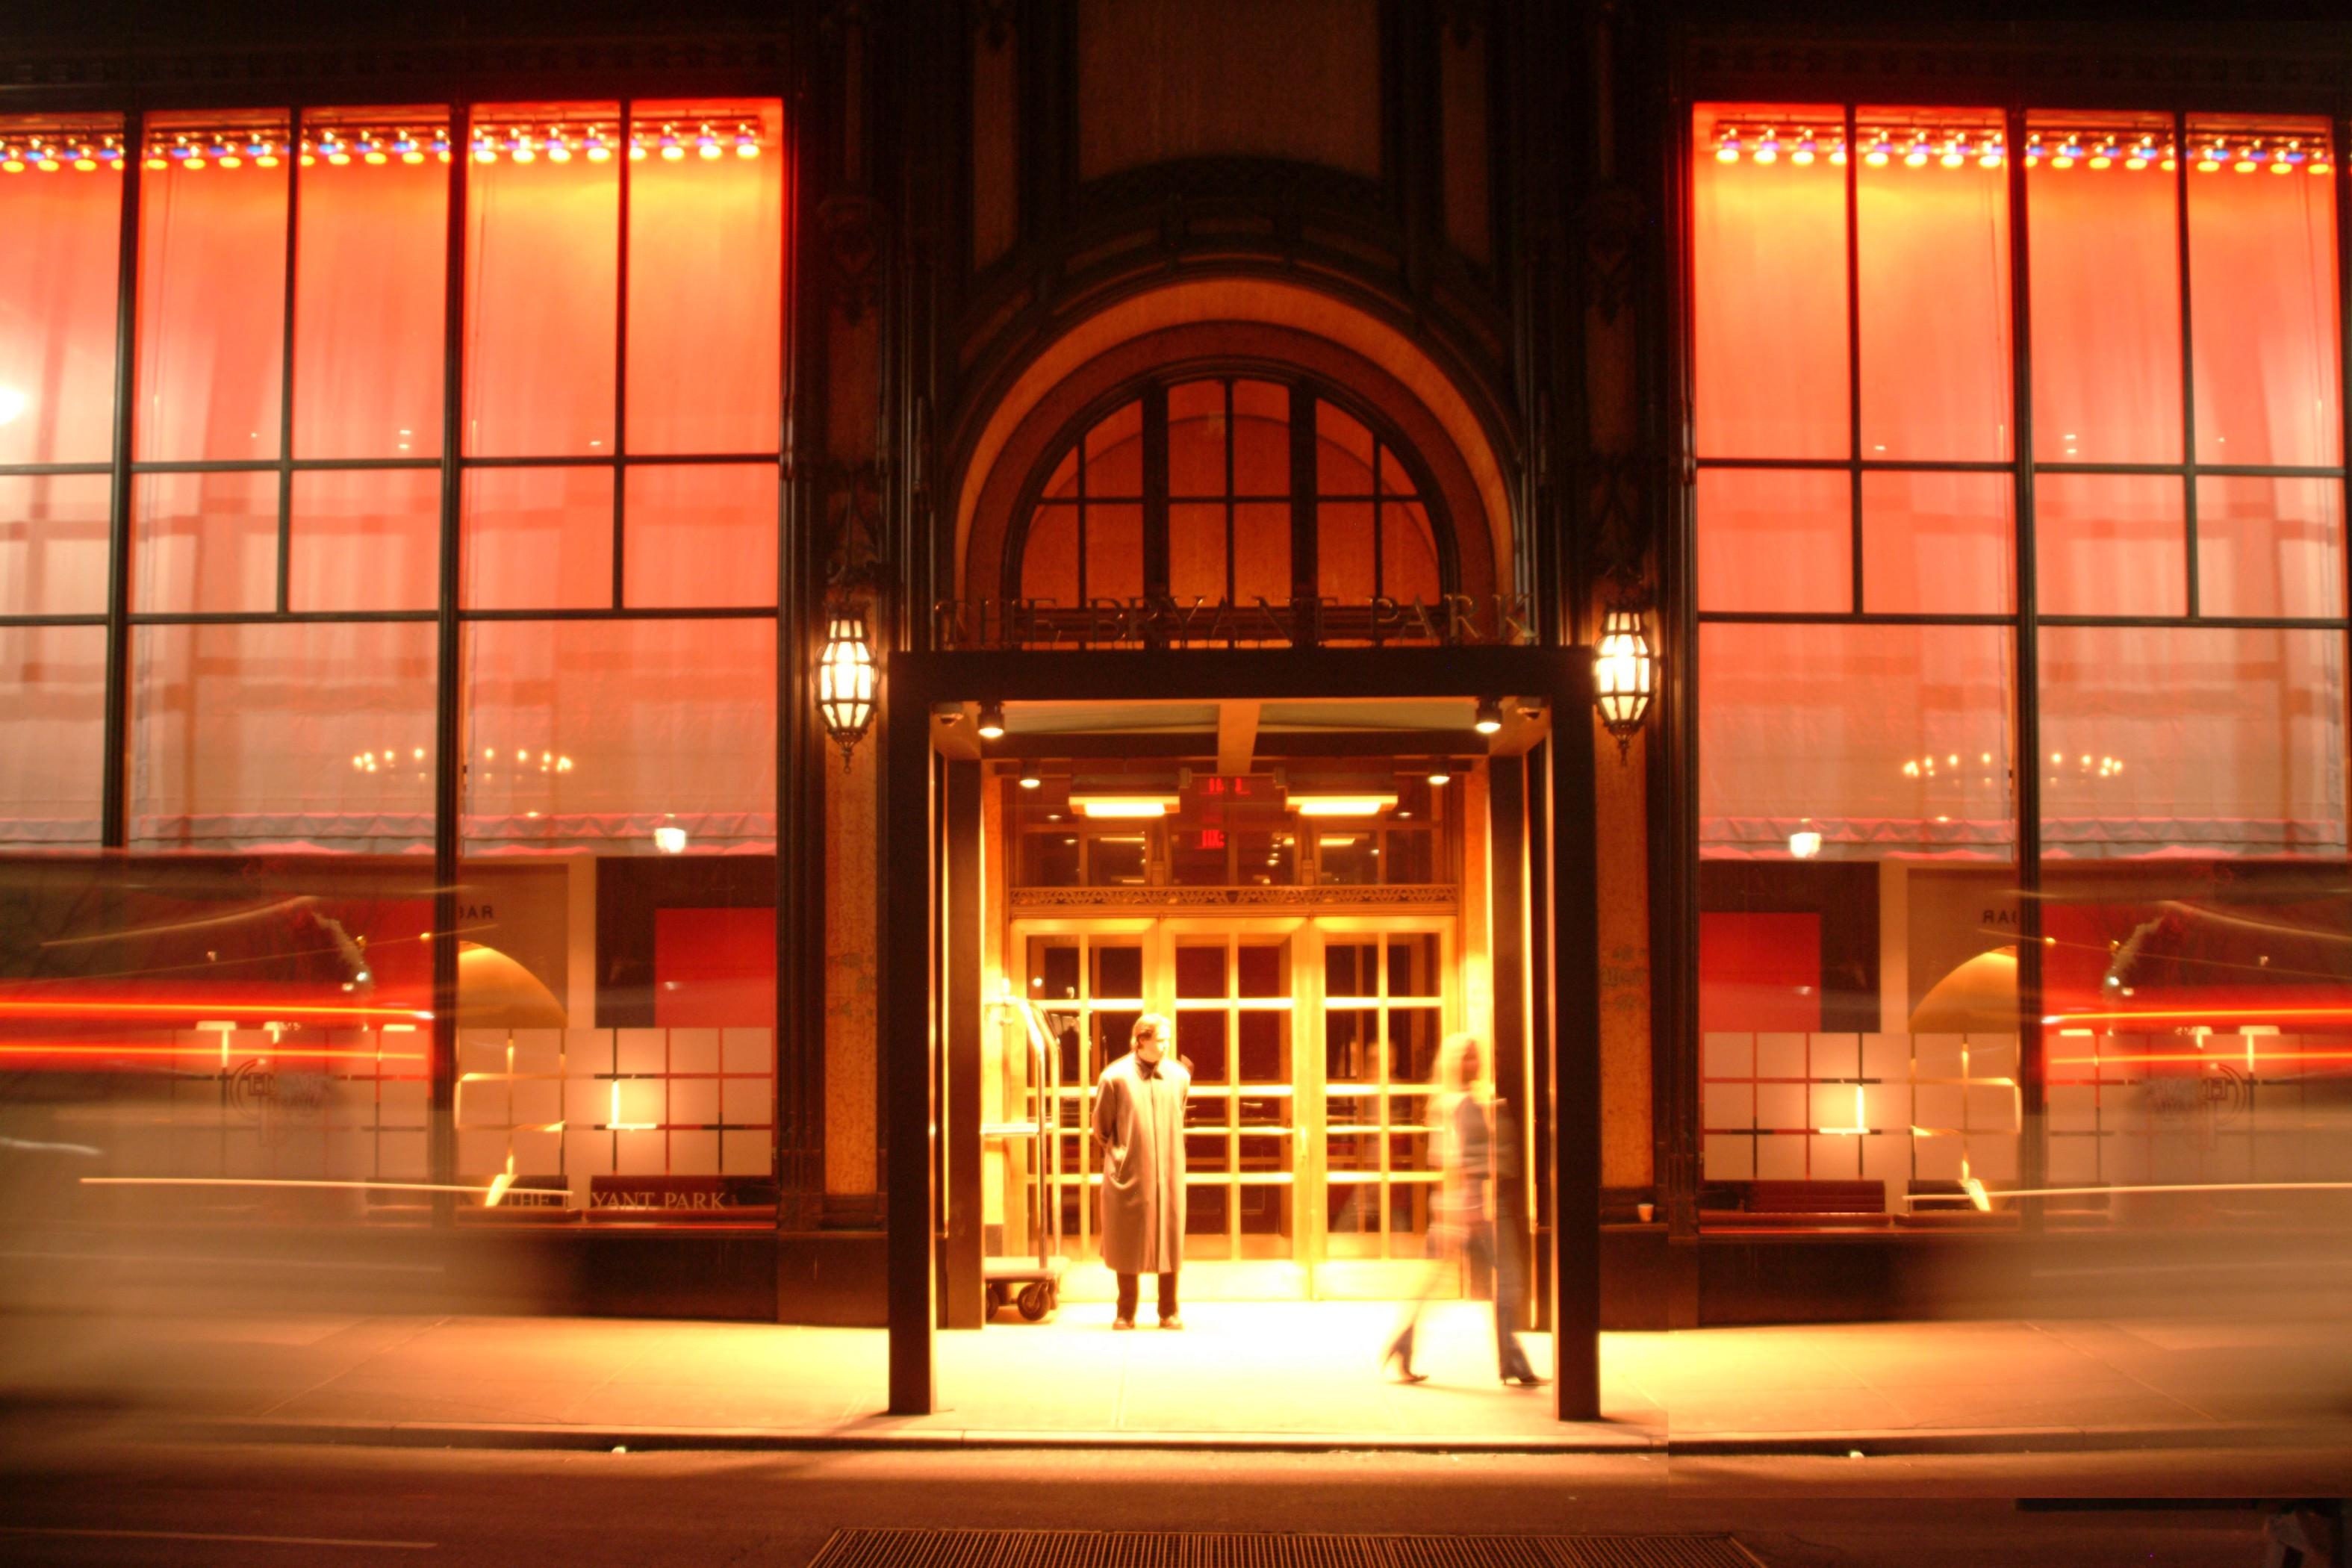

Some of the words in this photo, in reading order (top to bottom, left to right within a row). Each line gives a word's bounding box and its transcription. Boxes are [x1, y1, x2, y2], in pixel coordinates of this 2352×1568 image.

[1086, 596, 1339, 643] BRYANT
[1366, 594, 1538, 641] PARK
[563, 1191, 656, 1209] YANT
[663, 1192, 727, 1210] PARK
